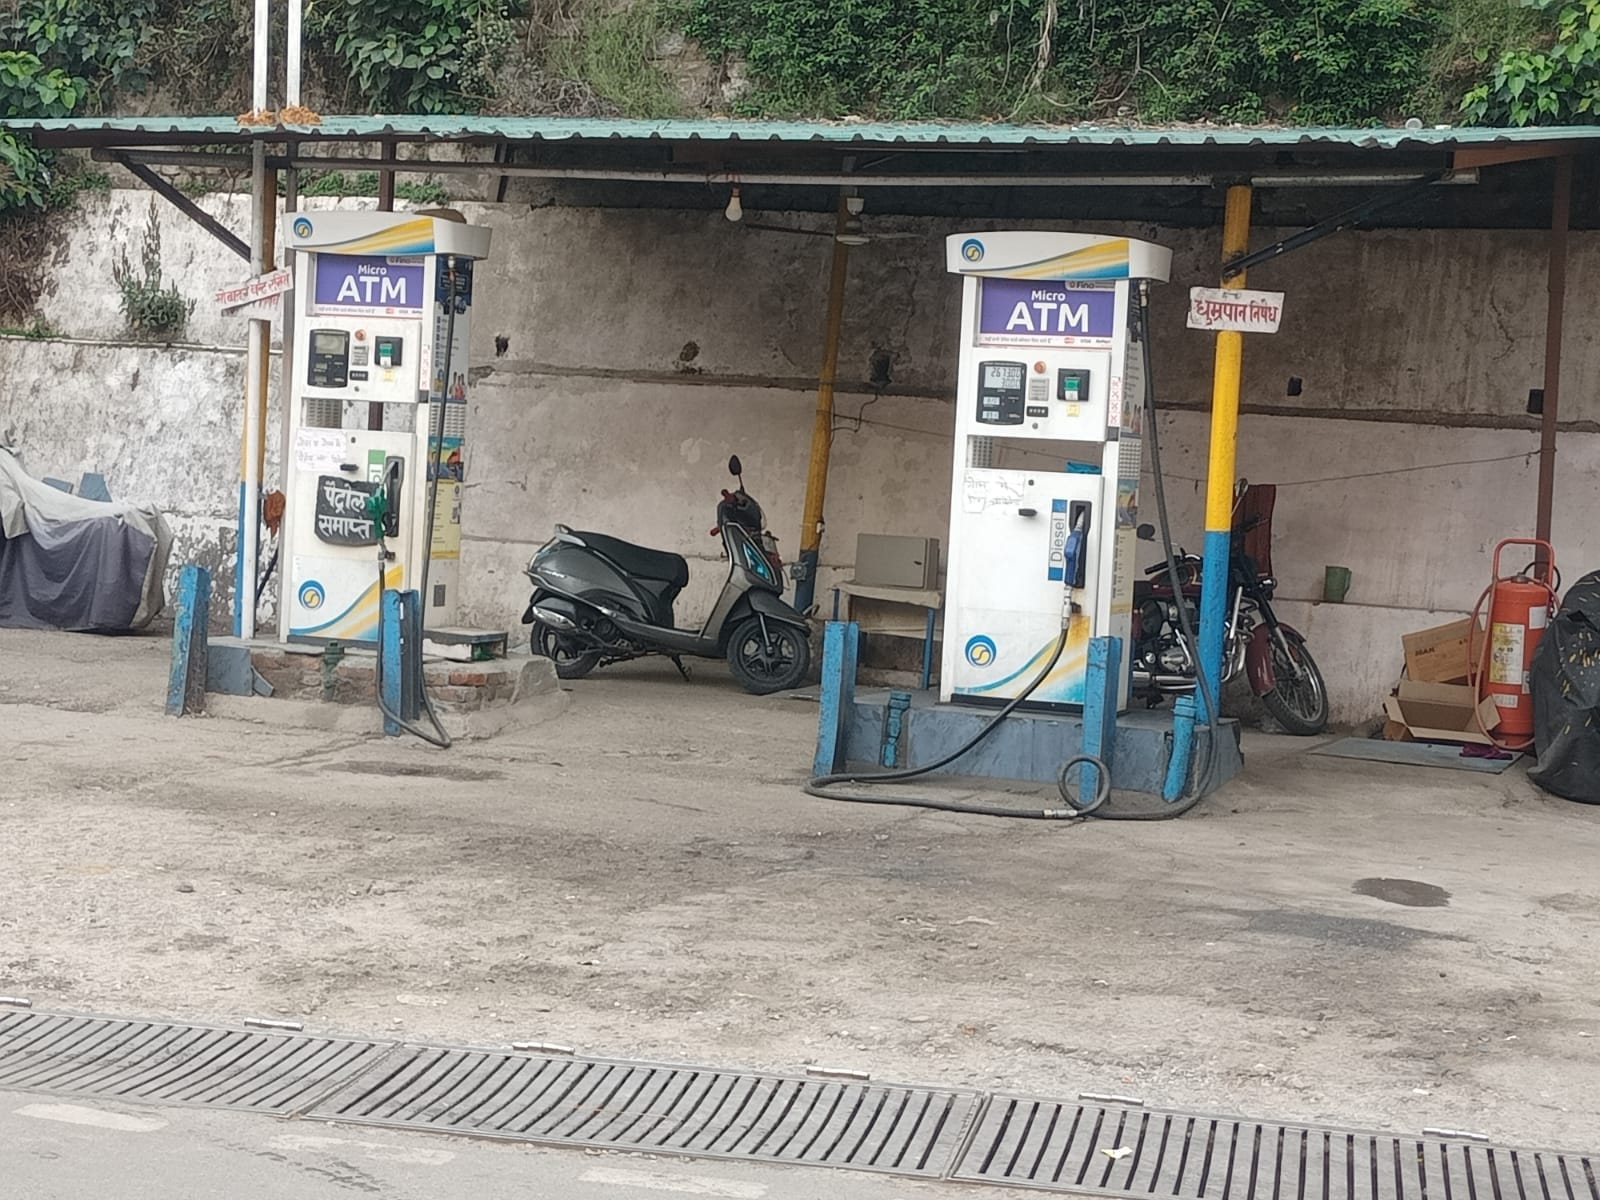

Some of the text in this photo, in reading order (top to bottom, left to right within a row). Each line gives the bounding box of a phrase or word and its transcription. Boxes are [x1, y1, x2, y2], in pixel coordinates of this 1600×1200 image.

[358, 264, 387, 275] Micro
[336, 275, 407, 305] ATM
[1031, 290, 1066, 302] Micro
[1005, 301, 1089, 333] ATM
[318, 514, 375, 540] समाप्त
[1050, 518, 1066, 562] Diesel
